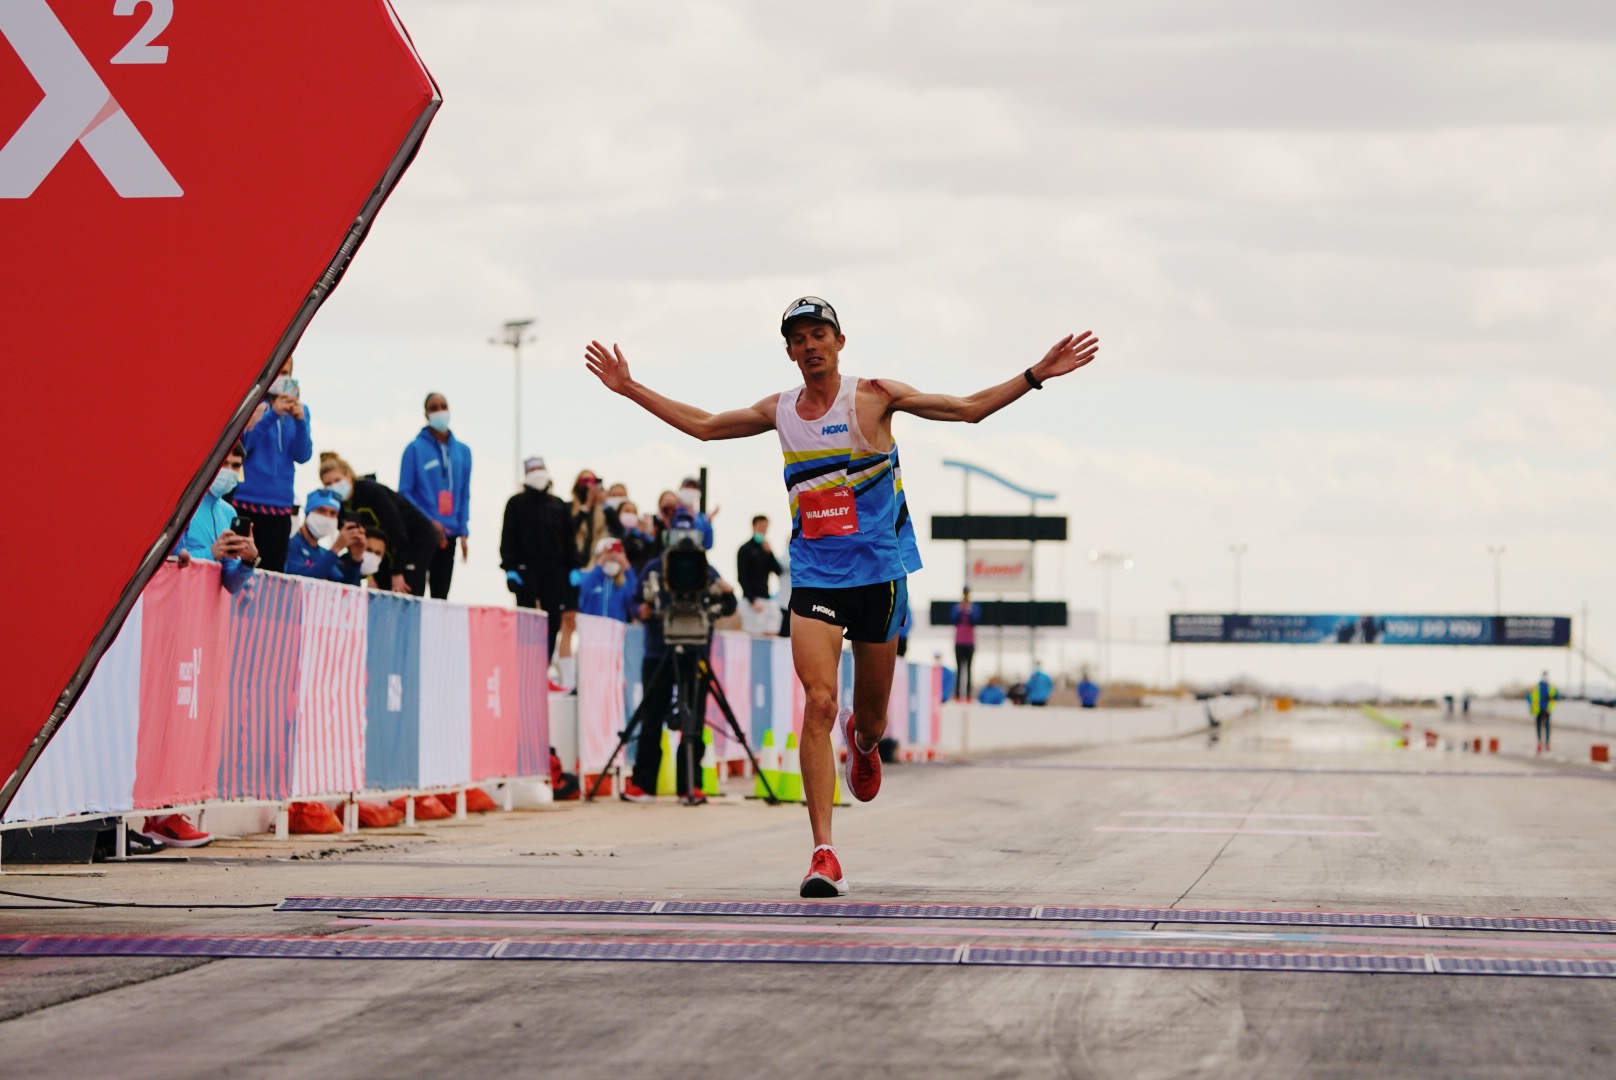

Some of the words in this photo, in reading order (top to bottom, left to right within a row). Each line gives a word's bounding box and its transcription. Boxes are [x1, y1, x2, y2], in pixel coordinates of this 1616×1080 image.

[821, 423, 849, 436] HOKA
[805, 506, 850, 519] WALMSLEY
[812, 604, 836, 618] HOKA
